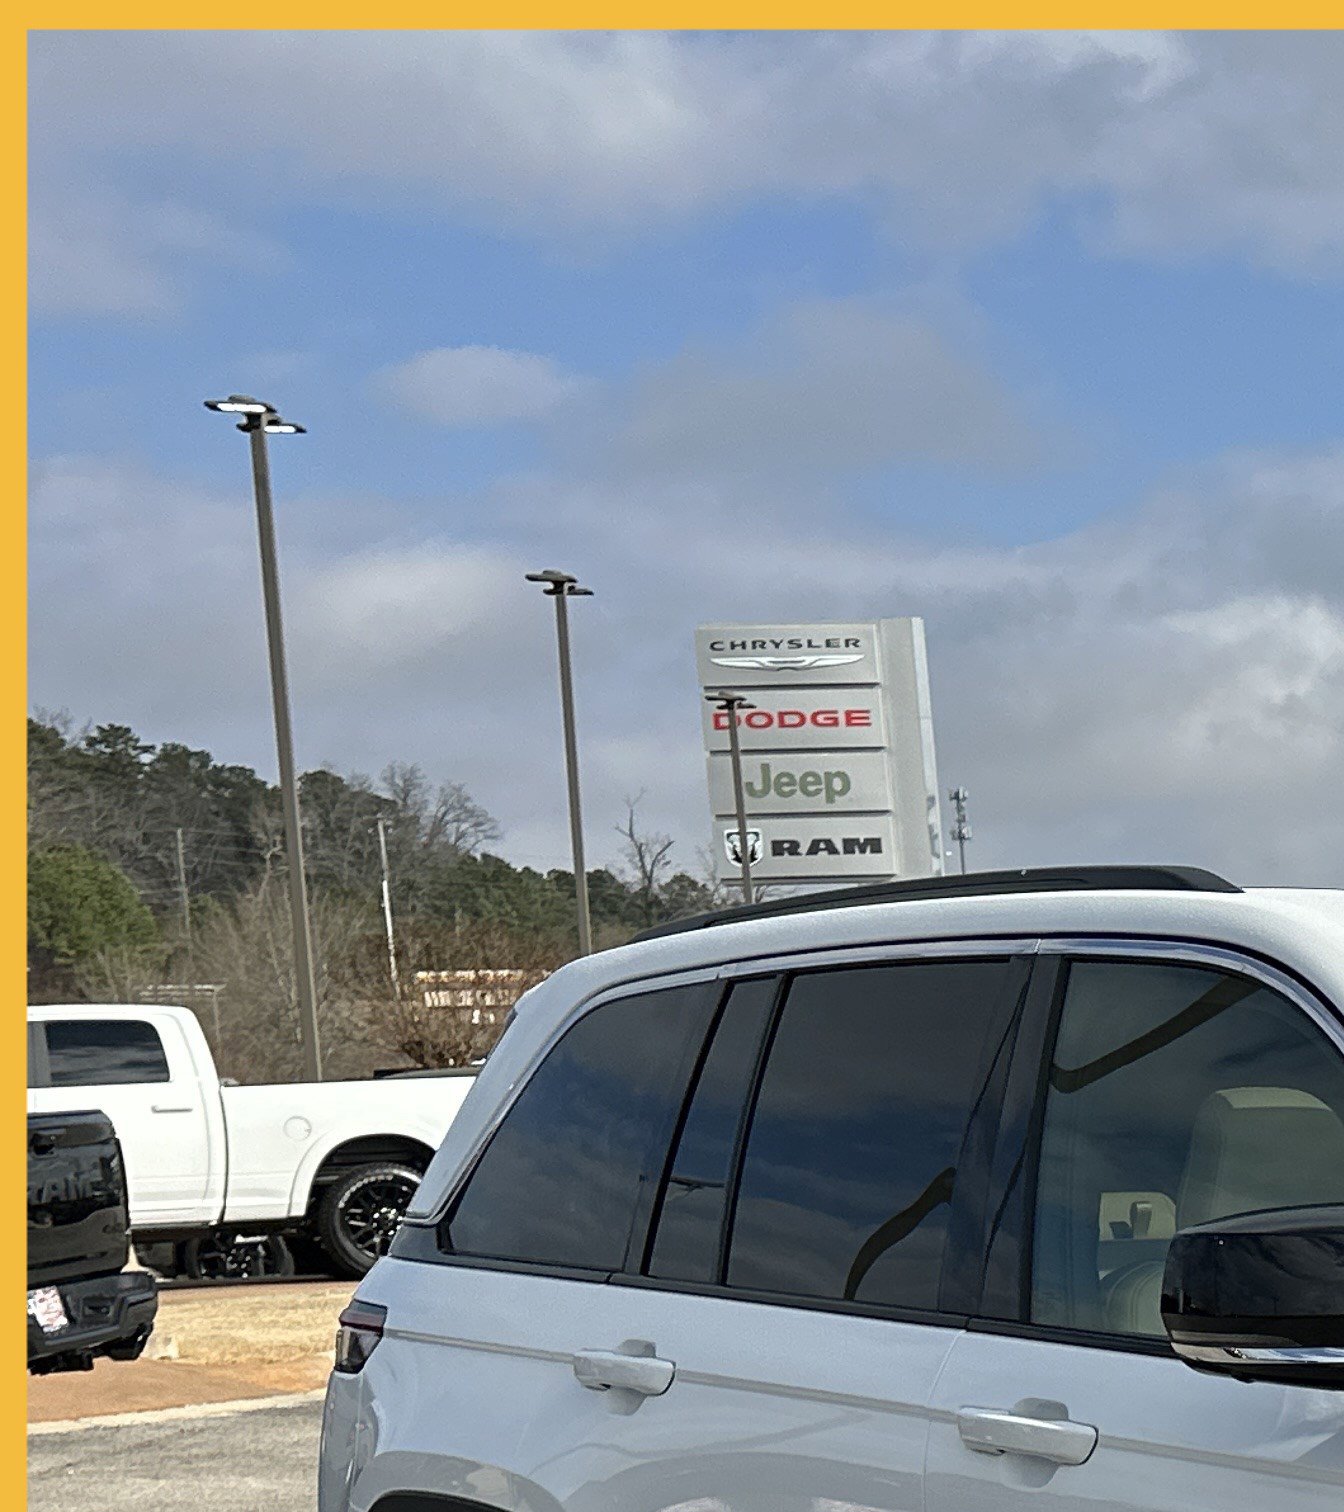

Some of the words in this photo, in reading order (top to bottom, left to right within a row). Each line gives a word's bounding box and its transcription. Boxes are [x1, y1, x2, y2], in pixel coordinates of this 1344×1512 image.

[709, 637, 861, 651] CHRYSLER
[712, 709, 872, 730] DODGE
[745, 763, 851, 803] Jeep
[770, 837, 883, 857] RAM
